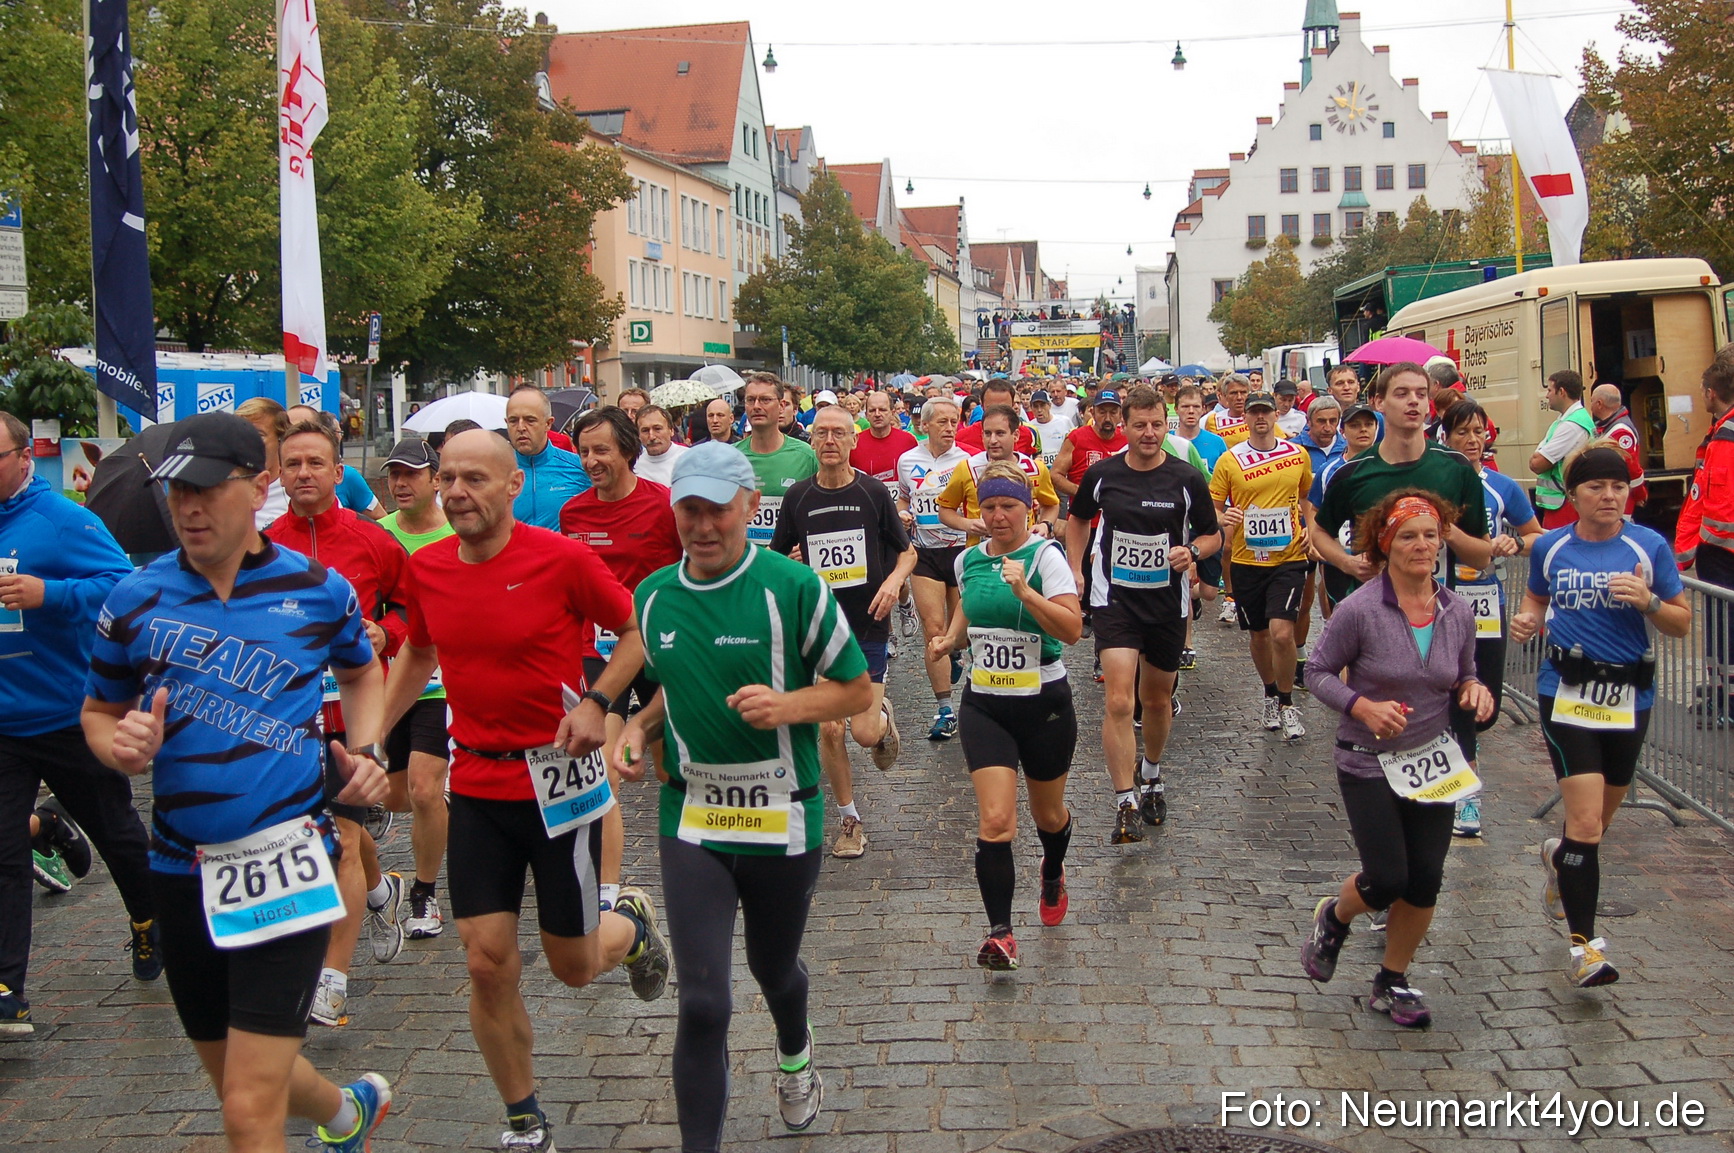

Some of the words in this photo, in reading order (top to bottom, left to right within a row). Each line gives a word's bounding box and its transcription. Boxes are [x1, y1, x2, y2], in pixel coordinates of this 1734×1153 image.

[633, 323, 650, 341] D
[1464, 318, 1514, 347] Bayerisches
[1040, 339, 1071, 347] START
[1464, 349, 1488, 368] Rotes
[1465, 372, 1487, 391] Kreuz
[1217, 429, 1237, 438] MAX
[1243, 466, 1273, 482] MAX
[1274, 457, 1304, 471] BÖGL
[746, 508, 780, 527] 59
[1248, 518, 1286, 536] 3041
[750, 528, 773, 538] Thoma
[826, 536, 855, 544] Neumarkt
[1114, 535, 1131, 545] PARTL
[1132, 539, 1160, 547] Neumarkt
[1259, 539, 1278, 547] Ralph
[819, 544, 856, 568] 263
[1116, 545, 1165, 568] 2528
[1128, 571, 1151, 581] Claus
[1556, 568, 1633, 590] Fitne
[1466, 589, 1490, 597] Neumarkt
[1470, 598, 1491, 617] 43
[714, 635, 747, 646] africon
[992, 635, 1028, 643] Neumarkt
[149, 617, 300, 701] TEAM
[983, 642, 1026, 670] 305
[989, 674, 1015, 686] Karin
[1574, 704, 1613, 722] Claudia
[529, 750, 562, 767] PARTL
[1382, 755, 1407, 768] PARTL
[1406, 741, 1440, 760] Neumarkt
[542, 748, 605, 801] 2439
[683, 766, 717, 781] PARTL
[718, 770, 771, 782] Neumarkt
[1401, 749, 1452, 789] 329
[570, 790, 603, 816] Gerald
[704, 783, 769, 809] 306
[705, 812, 762, 829] Stephen
[241, 832, 300, 858] Neumarkt
[215, 843, 320, 906] 2615
[253, 900, 299, 925] Horst
